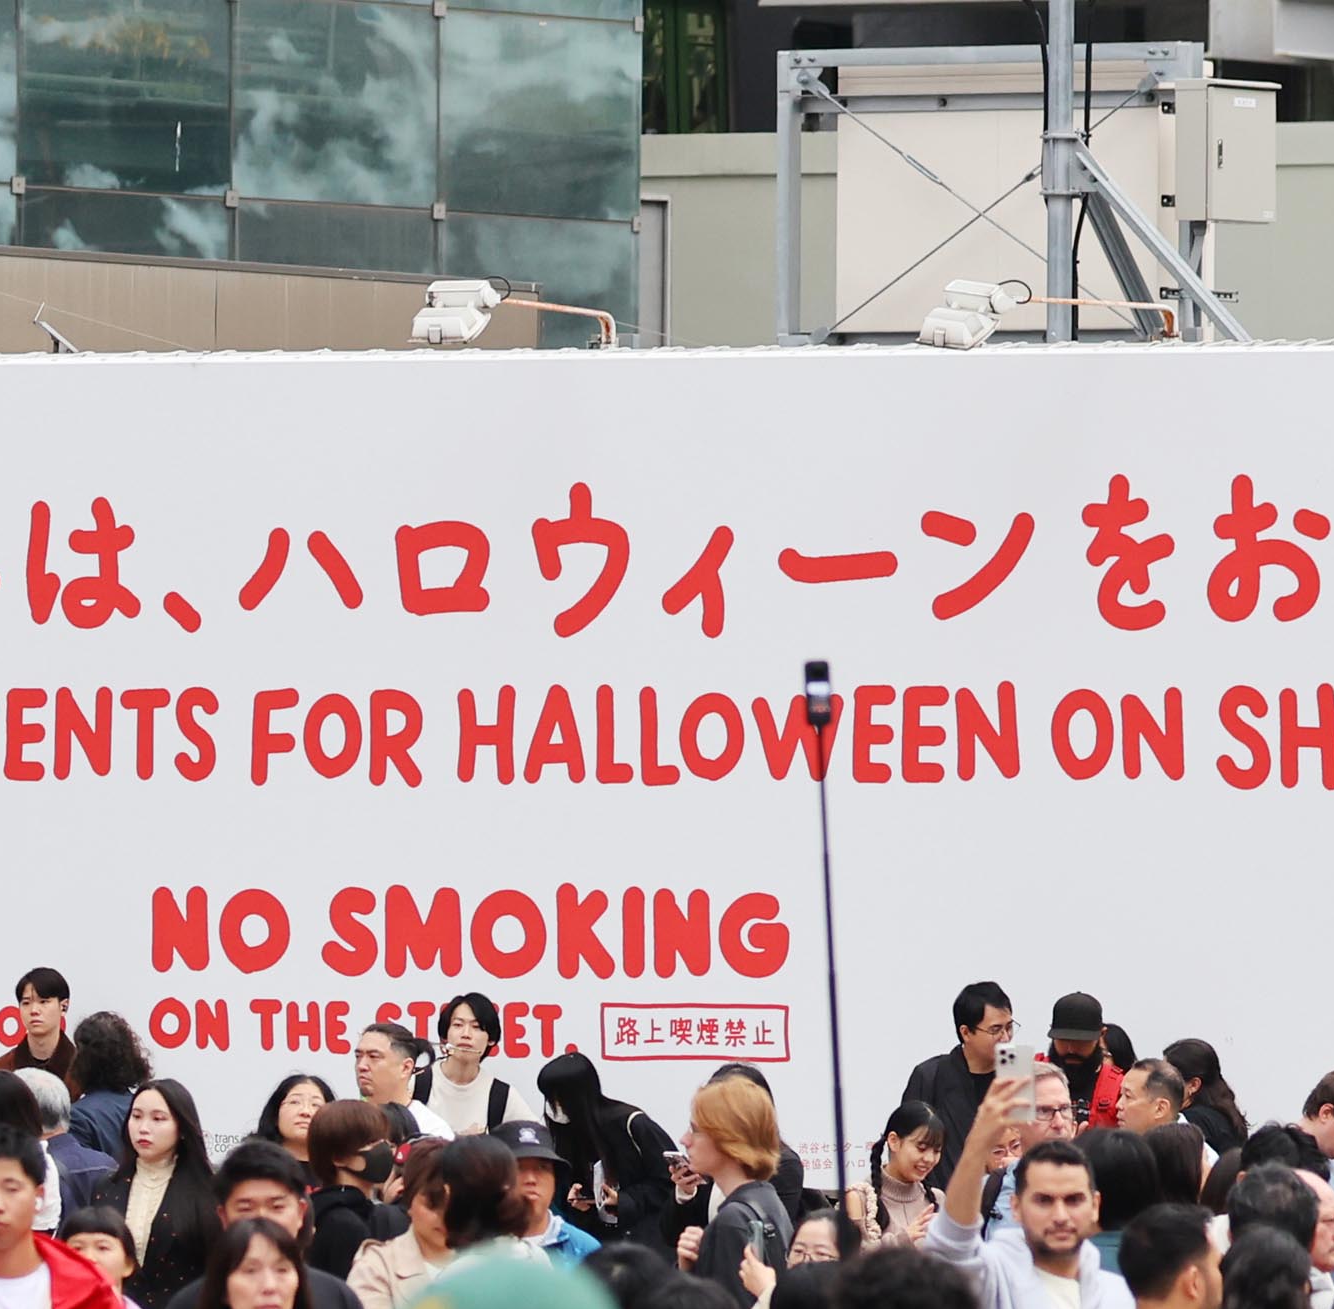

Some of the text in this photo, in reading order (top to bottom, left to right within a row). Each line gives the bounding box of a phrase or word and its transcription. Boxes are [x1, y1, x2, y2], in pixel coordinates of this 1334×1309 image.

[251, 688, 423, 788] FOR
[458, 681, 1020, 786] HALLOWEEN
[1052, 687, 1185, 781] ON
[152, 883, 790, 979] NO SMOKING
[149, 997, 230, 1051] ON
[250, 999, 351, 1054] THE
[614, 1016, 774, 1047] 路上喫煙禁止
